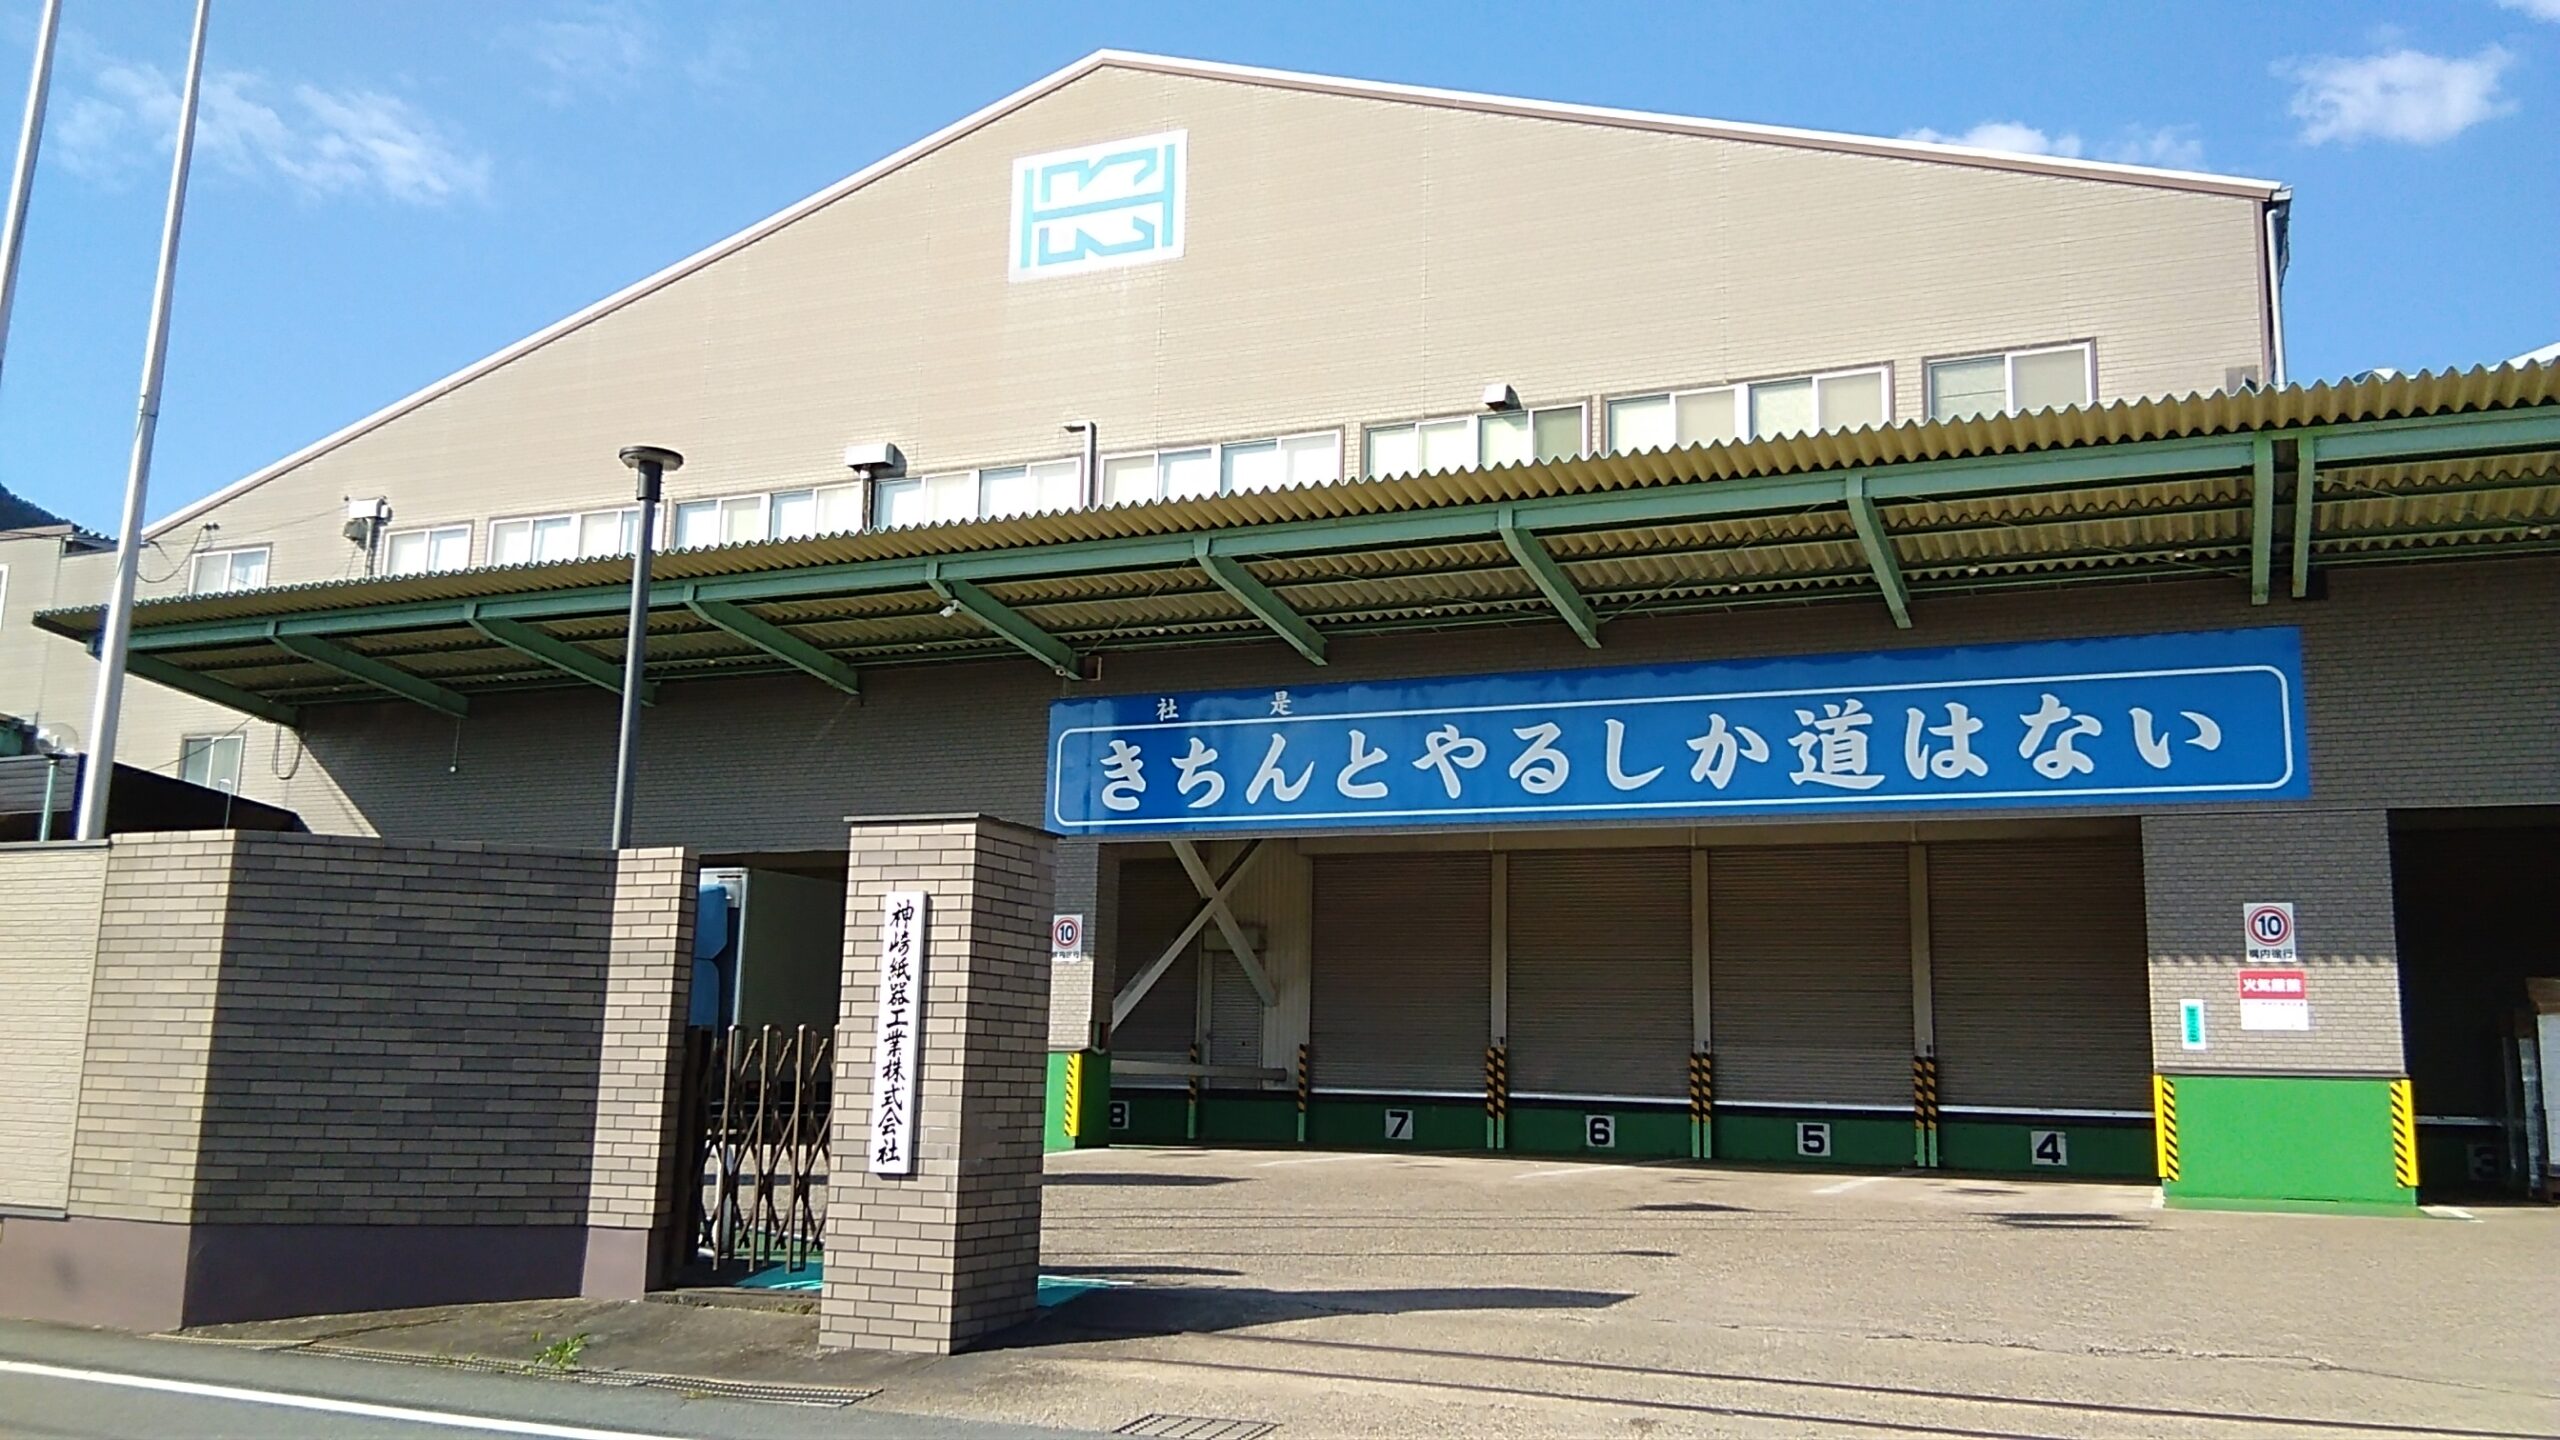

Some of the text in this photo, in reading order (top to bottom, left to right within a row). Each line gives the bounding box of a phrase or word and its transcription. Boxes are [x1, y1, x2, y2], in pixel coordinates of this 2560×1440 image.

[1099, 692, 2223, 813] きちんとやるしか道はない
[1060, 925, 1074, 941] 10
[2258, 915, 2282, 937] 10
[1110, 1102, 1126, 1128] 8
[1389, 1111, 1409, 1138] 7
[1589, 1117, 1610, 1146] 6
[1802, 1125, 1825, 1153] 5
[2036, 1133, 2061, 1163] 4
